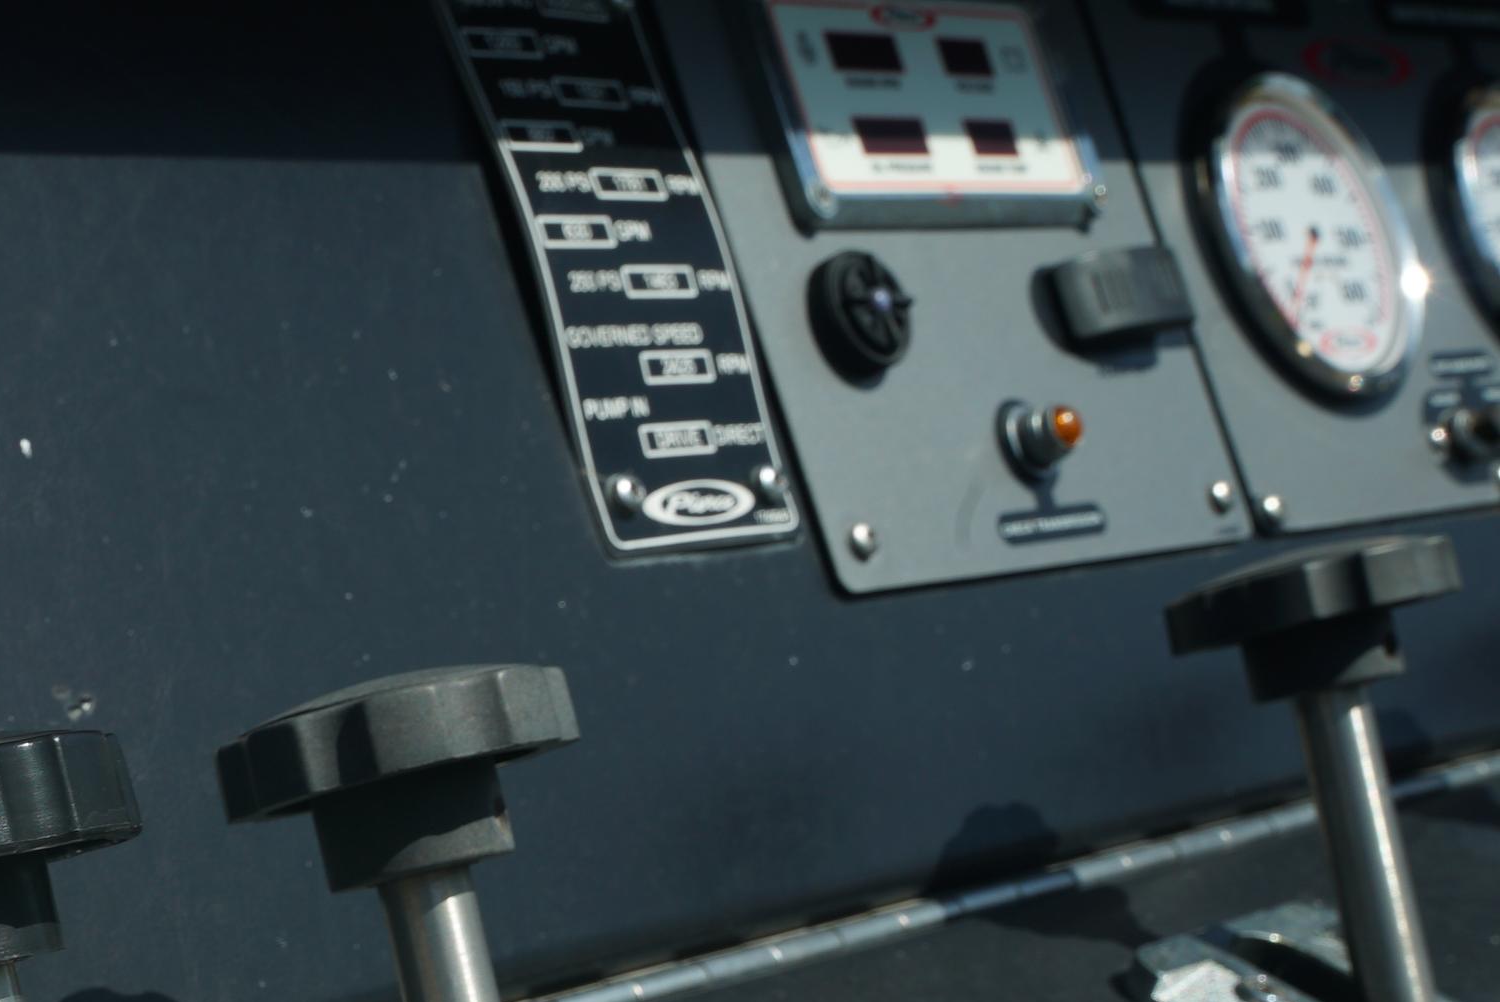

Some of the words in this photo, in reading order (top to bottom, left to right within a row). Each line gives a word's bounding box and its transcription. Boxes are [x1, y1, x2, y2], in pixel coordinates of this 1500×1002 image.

[565, 325, 651, 349] GOVERNED
[651, 322, 704, 346] SPEED
[582, 398, 628, 421] PUMP
